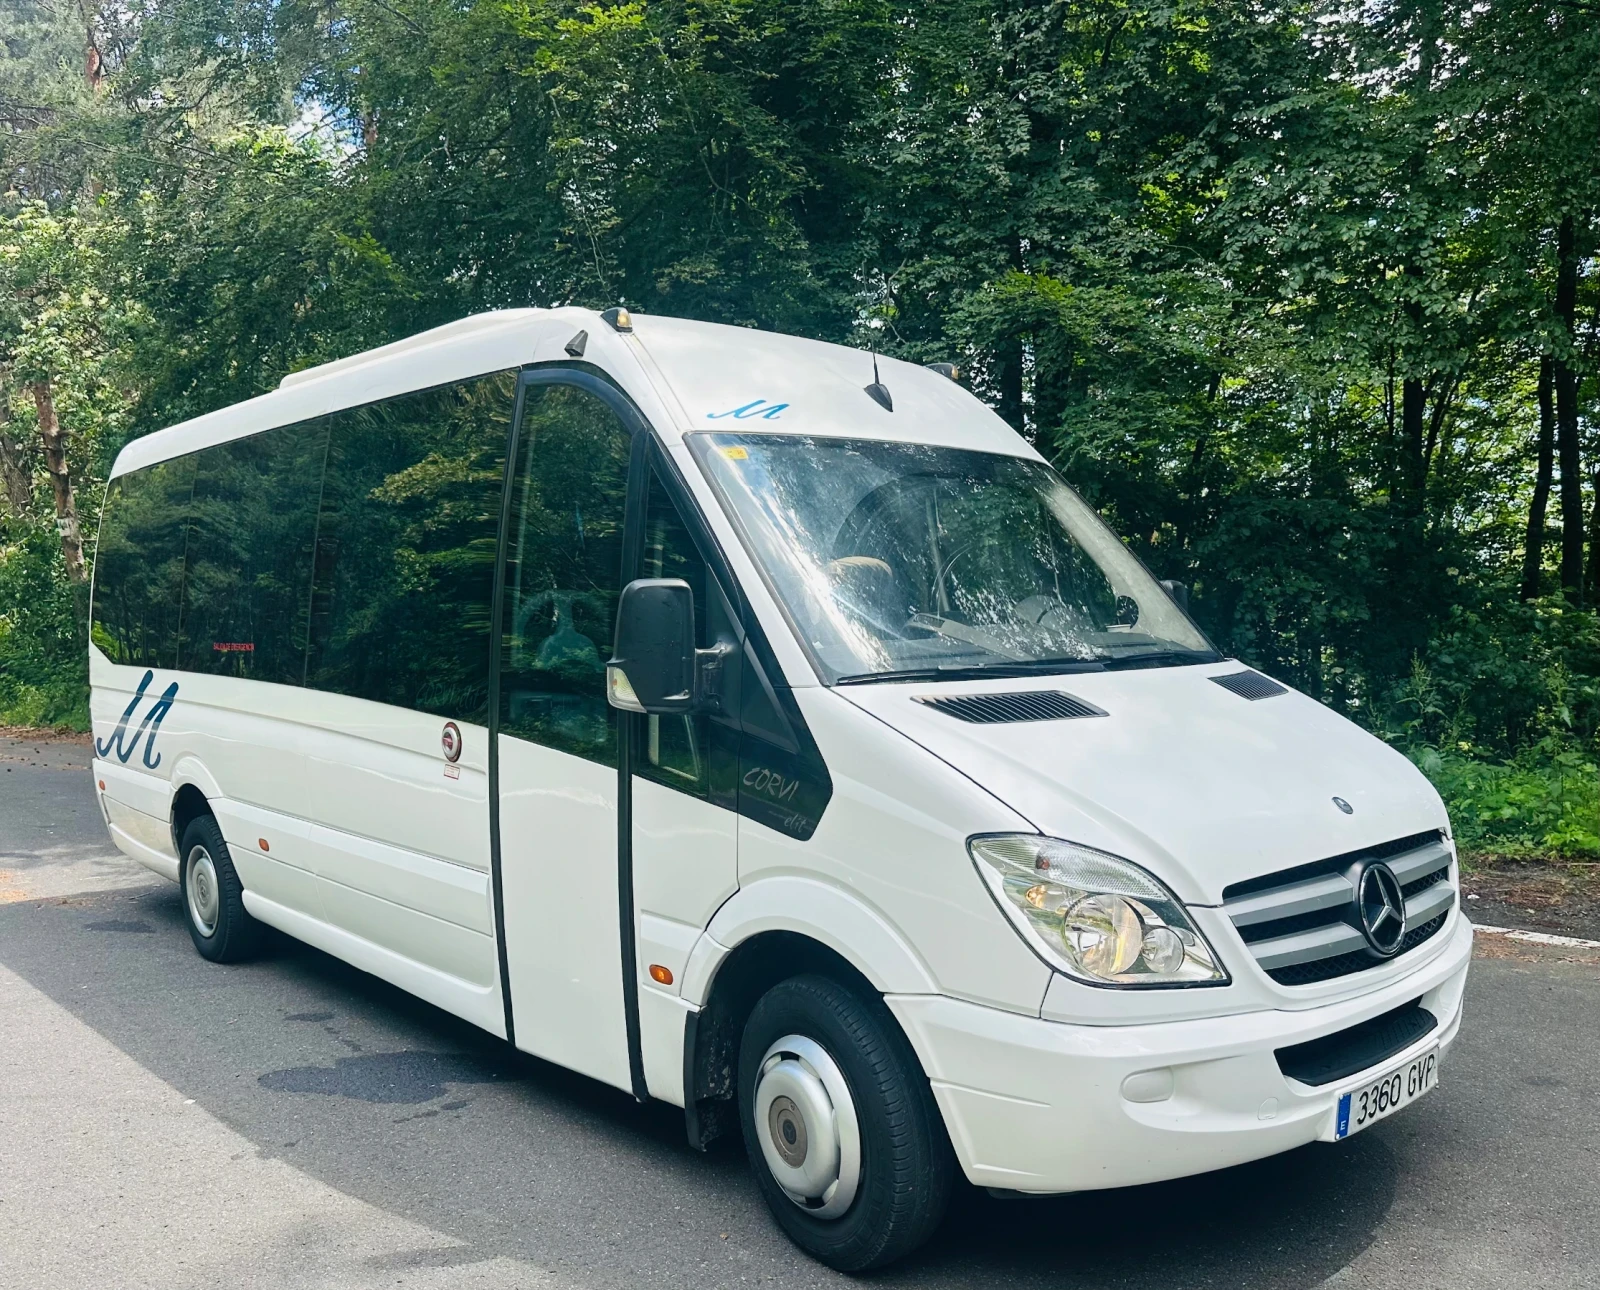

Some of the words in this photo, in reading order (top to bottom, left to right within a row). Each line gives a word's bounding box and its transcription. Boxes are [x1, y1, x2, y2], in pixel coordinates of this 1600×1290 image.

[743, 767, 800, 802] CORVI
[1356, 1073, 1402, 1125] 3360
[1407, 1053, 1435, 1097] GVP
[1340, 1120, 1347, 1130] E
